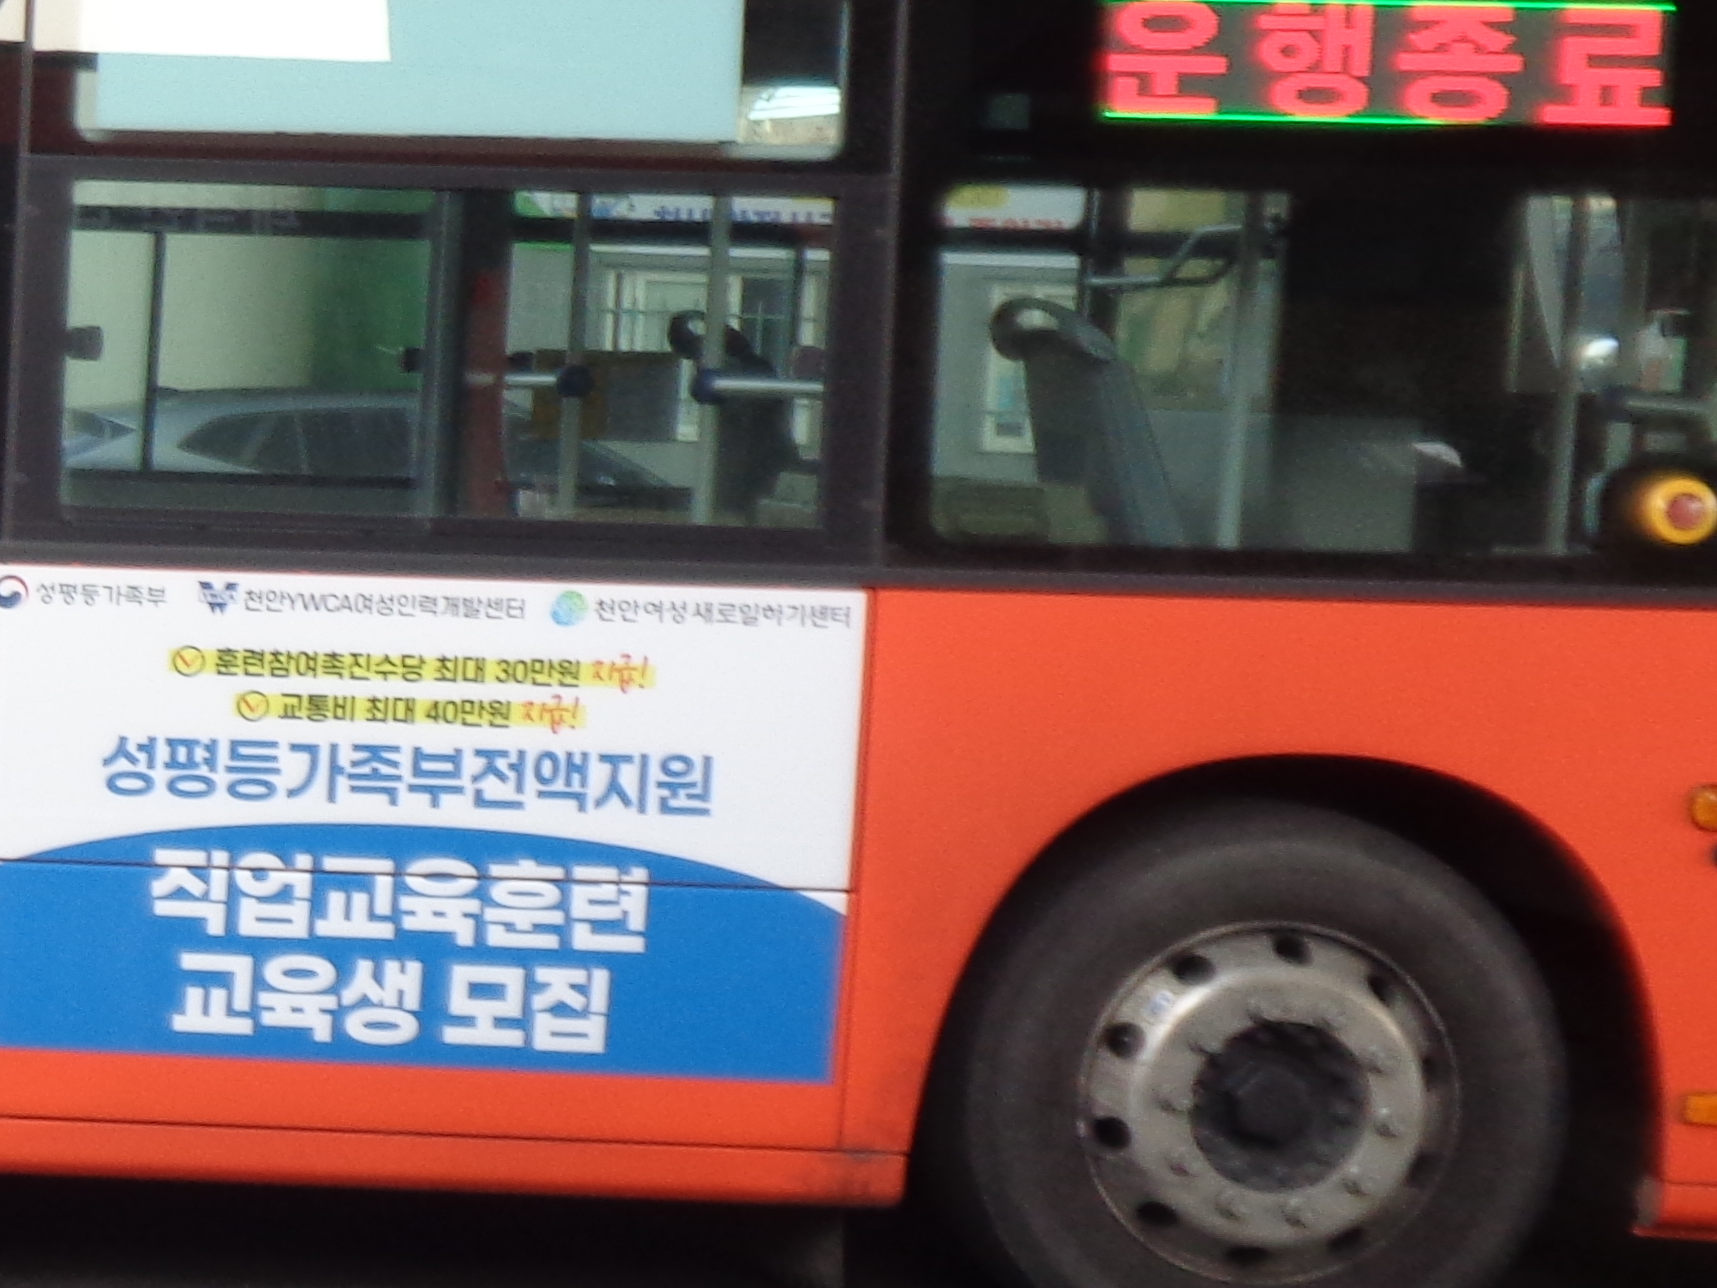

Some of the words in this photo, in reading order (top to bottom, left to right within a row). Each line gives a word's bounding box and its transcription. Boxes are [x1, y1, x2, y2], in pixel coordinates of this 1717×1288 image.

[1103, 0, 1673, 126] 운행종료
[35, 581, 168, 607] 성평등가족부
[243, 587, 526, 621] 천안YWCA여성인력개발센터
[215, 647, 426, 682] 훈련참여촉진수당
[434, 654, 486, 684] 최대
[495, 657, 581, 688] 30만원
[591, 652, 648, 694] 지급!
[277, 692, 356, 723] 교통비
[365, 696, 416, 726] 최대
[425, 699, 512, 729] 40만원
[521, 693, 580, 735] 지급!
[101, 734, 714, 817] 성평등가족부전액지원
[151, 848, 650, 954] 직업교육훈련
[171, 952, 424, 1046] 교육생
[441, 963, 611, 1054] 모집
